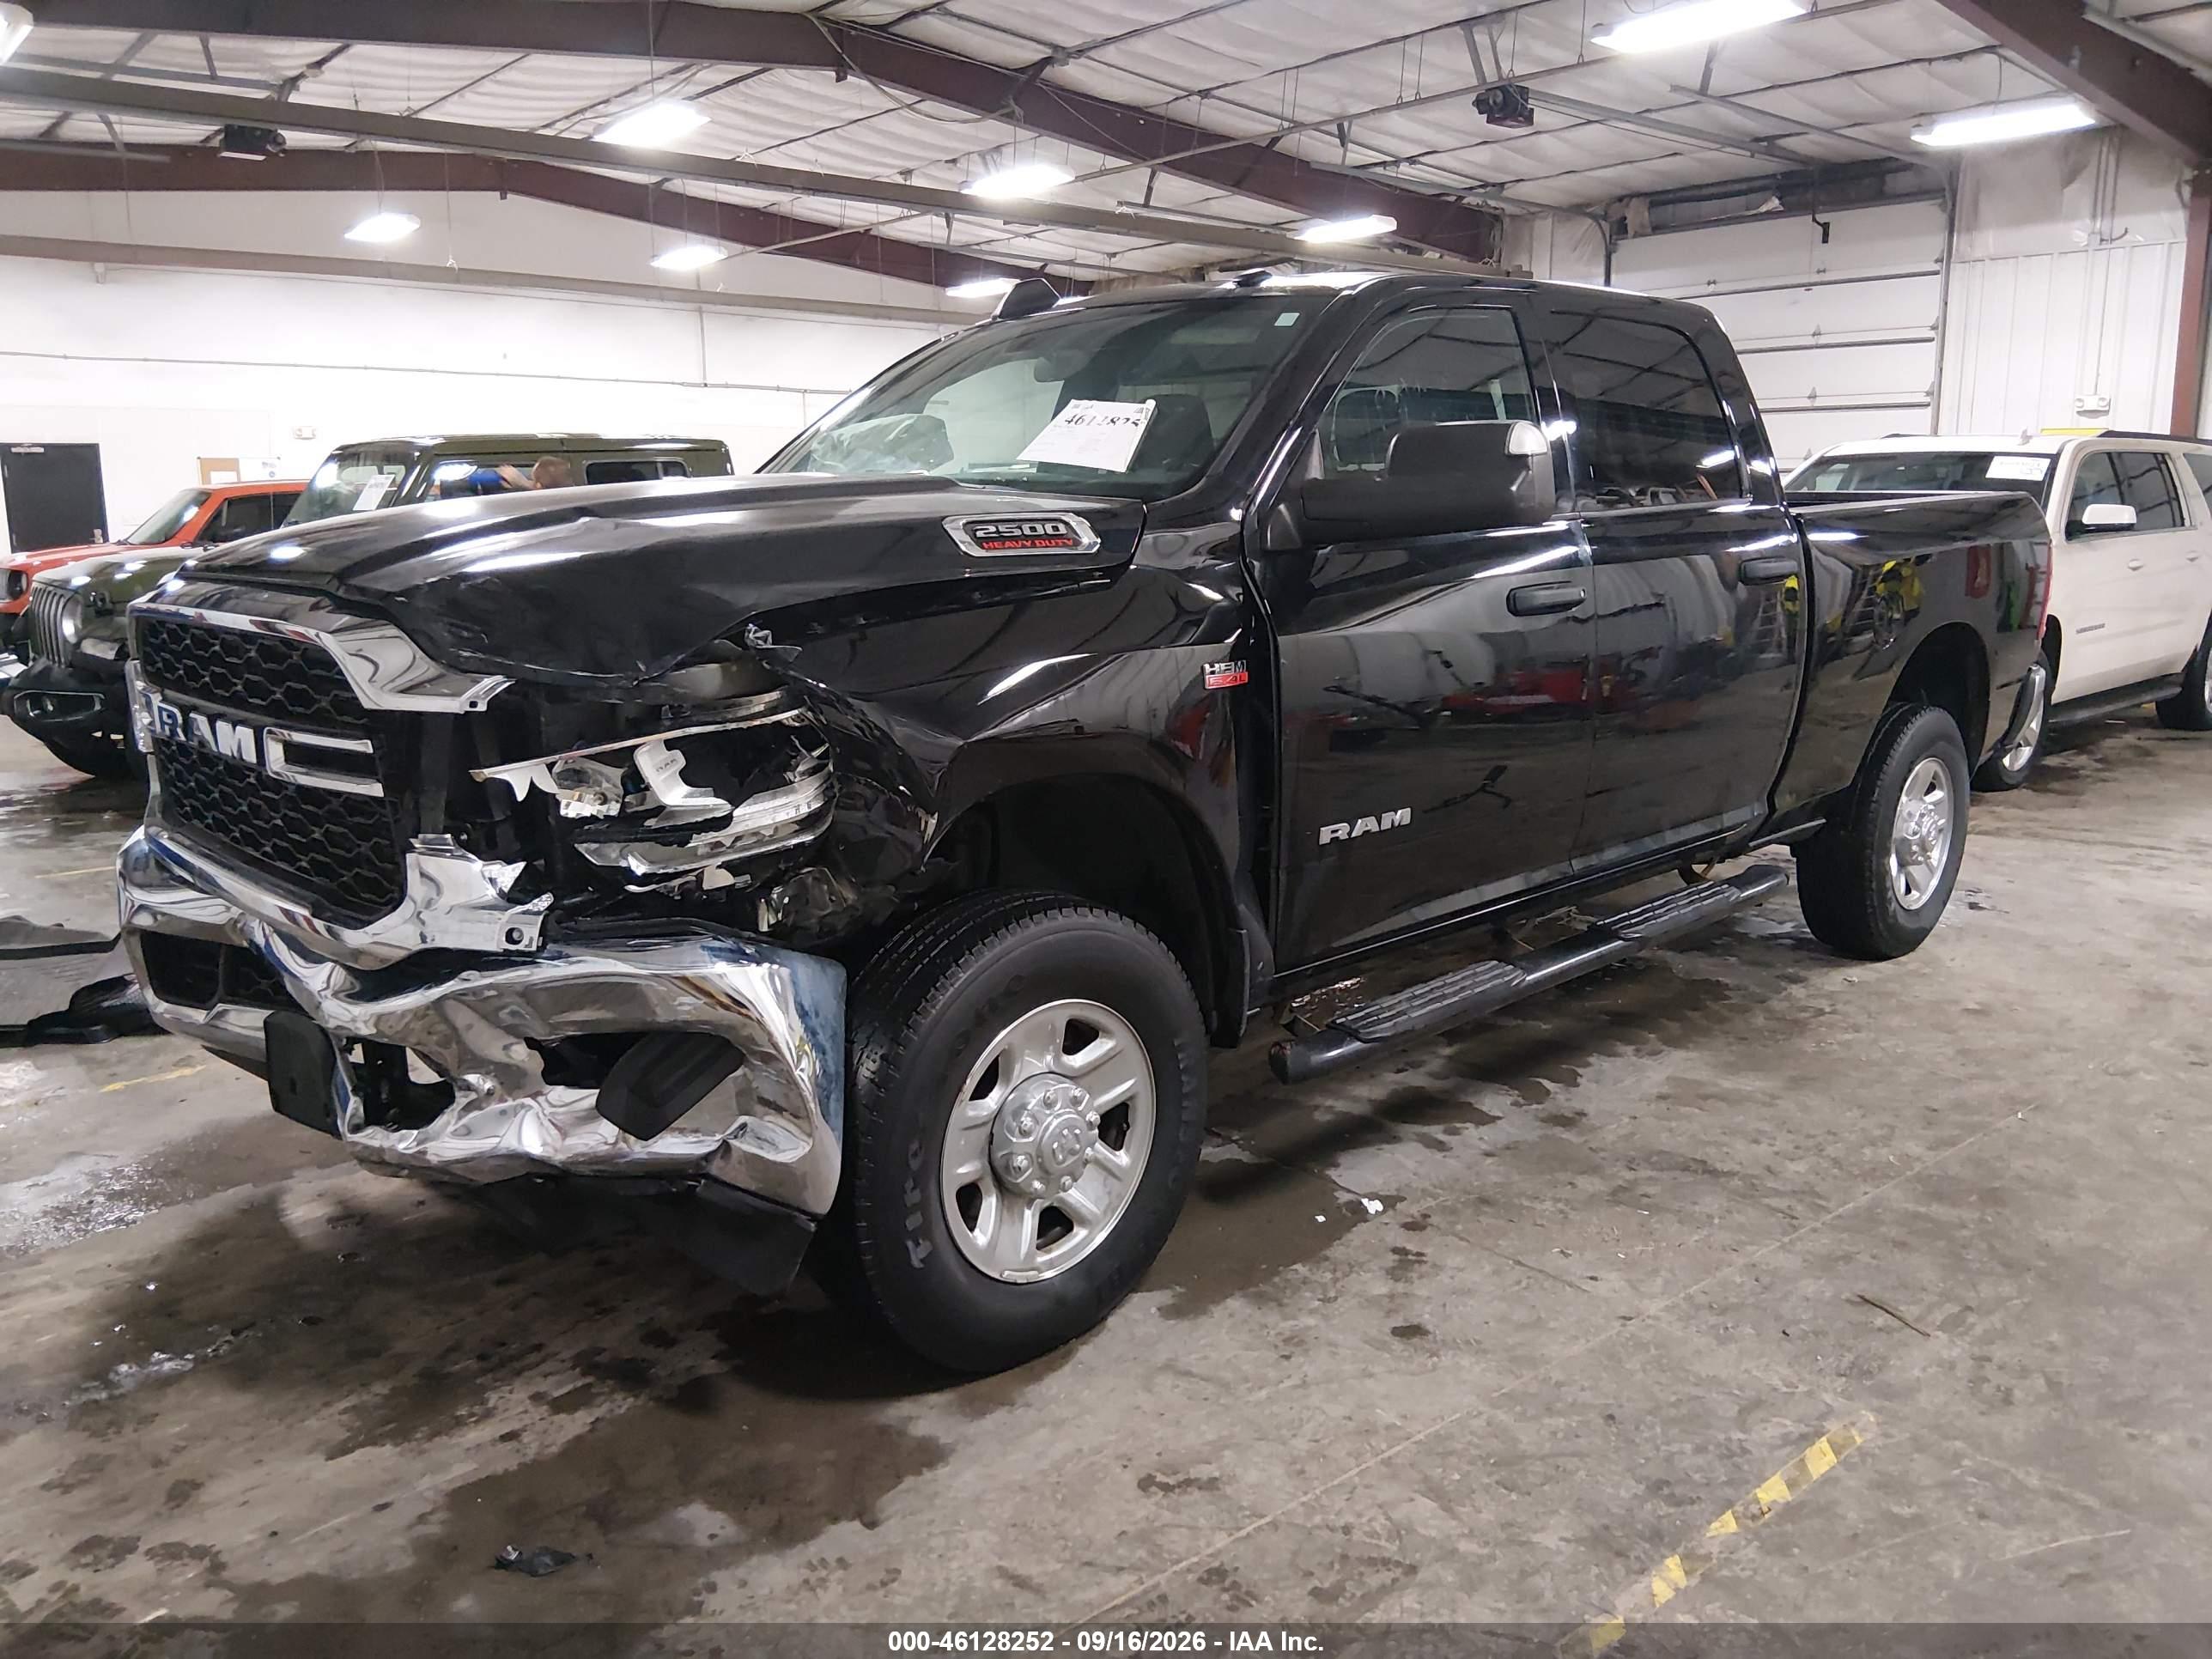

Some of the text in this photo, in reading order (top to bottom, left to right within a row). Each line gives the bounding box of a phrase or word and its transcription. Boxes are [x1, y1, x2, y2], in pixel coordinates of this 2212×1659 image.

[975, 522, 1067, 538] 2500
[982, 538, 1073, 550] HEAVY DUTY
[1203, 659, 1247, 676] HEMI
[157, 699, 258, 764] RAM
[1318, 807, 1411, 846] RAM
